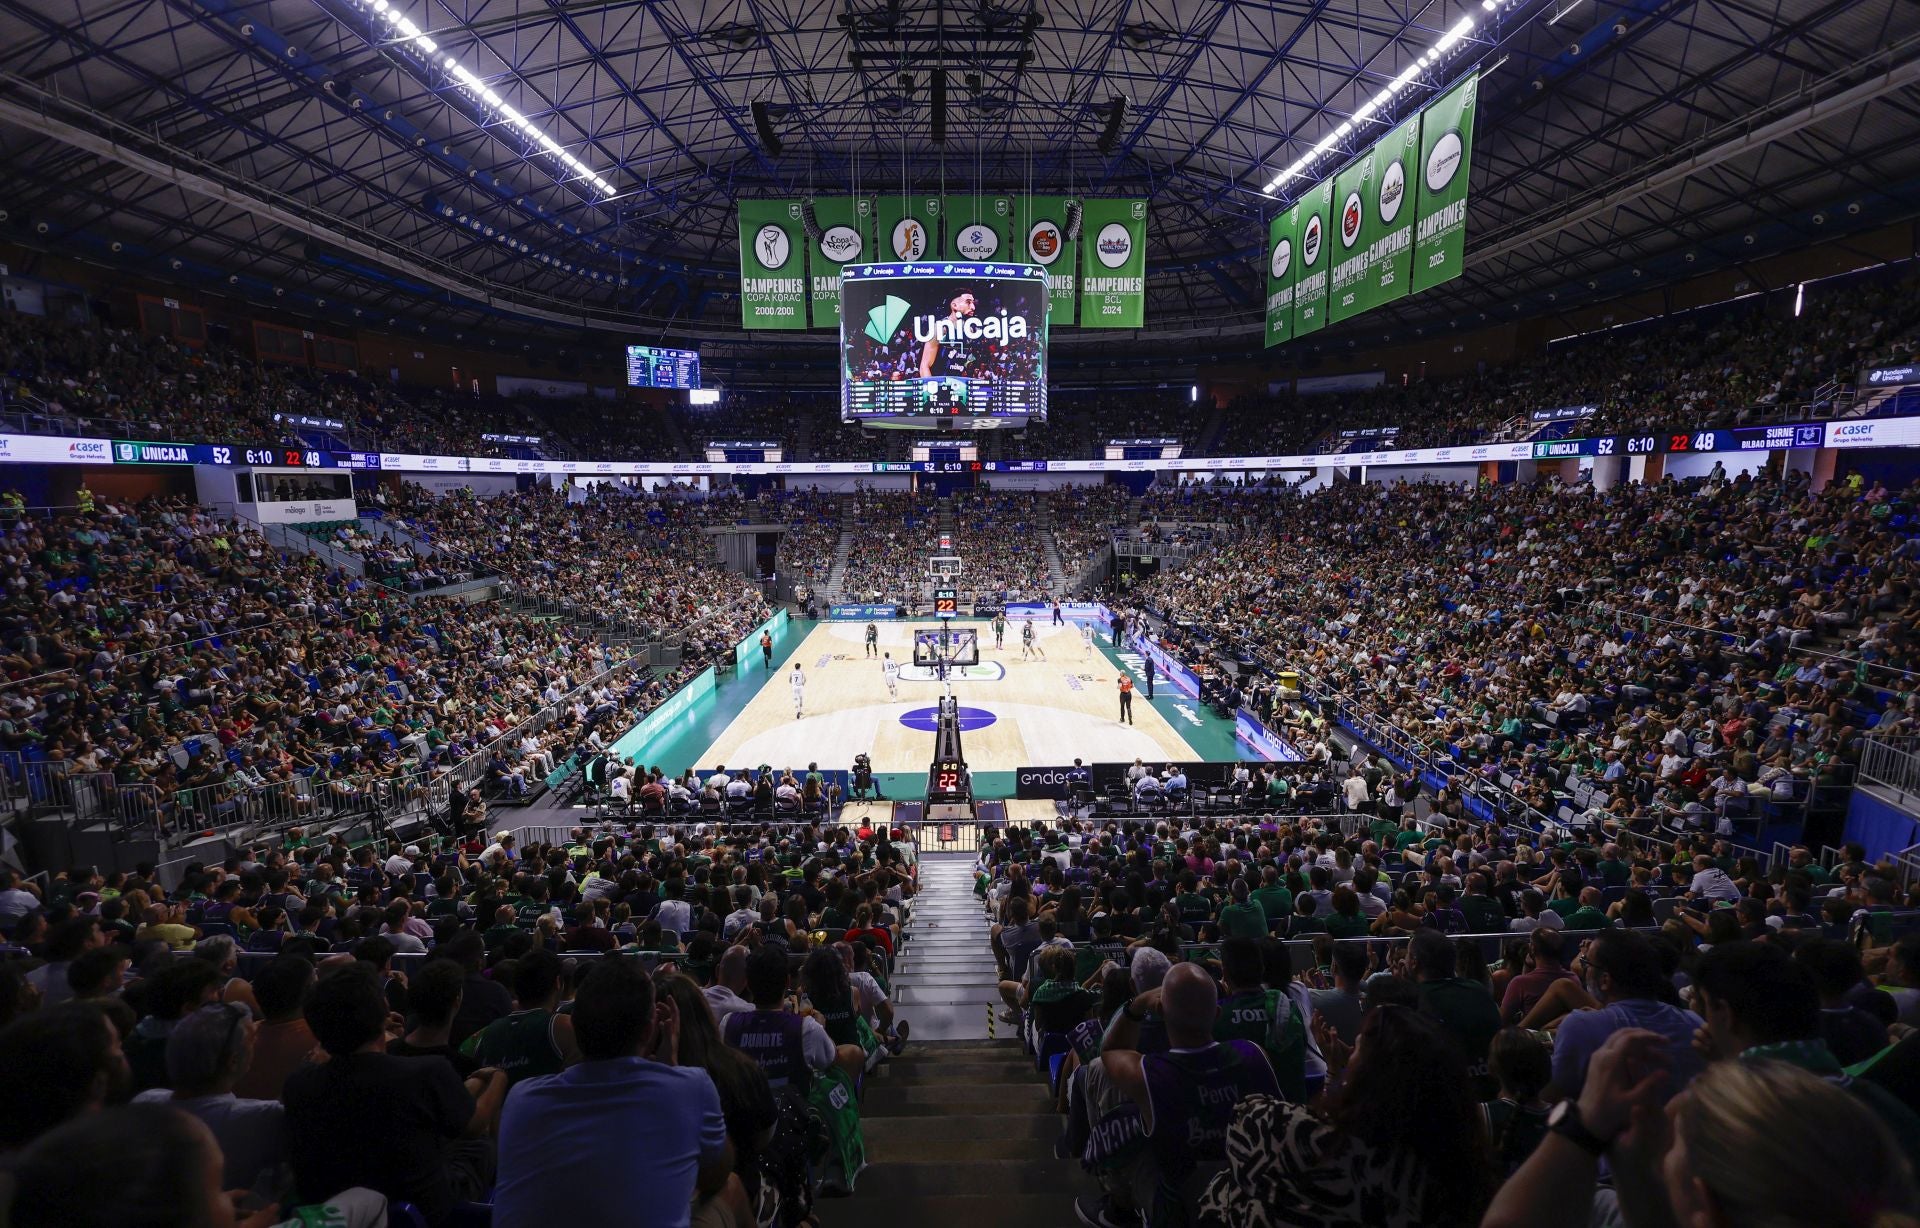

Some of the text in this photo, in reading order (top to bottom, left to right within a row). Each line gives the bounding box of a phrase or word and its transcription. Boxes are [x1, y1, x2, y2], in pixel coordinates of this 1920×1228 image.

[1417, 198, 1466, 242] CAMPEONES
[962, 245, 993, 254] EuroCup
[1369, 225, 1411, 263] CAMPEONES
[1429, 250, 1445, 268] 2025
[873, 268, 894, 276] Unicaja
[953, 267, 976, 275] Unicaja
[994, 267, 1016, 276] Unicaja
[1333, 250, 1369, 284] CAMPEONES
[1085, 277, 1142, 292] CAMPEONES
[1381, 271, 1394, 287] 2025
[744, 278, 803, 293] CAMPEONES
[747, 293, 801, 302] COPA KORAC
[814, 291, 836, 300] COPA
[1056, 290, 1073, 298] REY
[1104, 296, 1122, 304] BCL
[755, 306, 794, 315] 2000/2001
[1102, 305, 1122, 314] 2024
[914, 309, 1028, 347] Unicaja
[1766, 427, 1794, 439] SURNE
[1842, 424, 1874, 435] caser
[76, 442, 104, 452] caser
[1549, 433, 1715, 456] UNICAJA 52 6:10 22 48
[1742, 438, 1793, 449] BILBAO BASKET
[142, 446, 320, 466] UNICAJA 52 6:10 22 48
[886, 463, 911, 471] UNICAJA
[924, 463, 935, 471] 52
[985, 462, 995, 471] 48
[938, 600, 954, 611] 22
[975, 603, 1005, 613] endesa
[939, 773, 957, 788] 22
[740, 1032, 784, 1048] DUARTE
[1198, 1083, 1239, 1106] Perry
